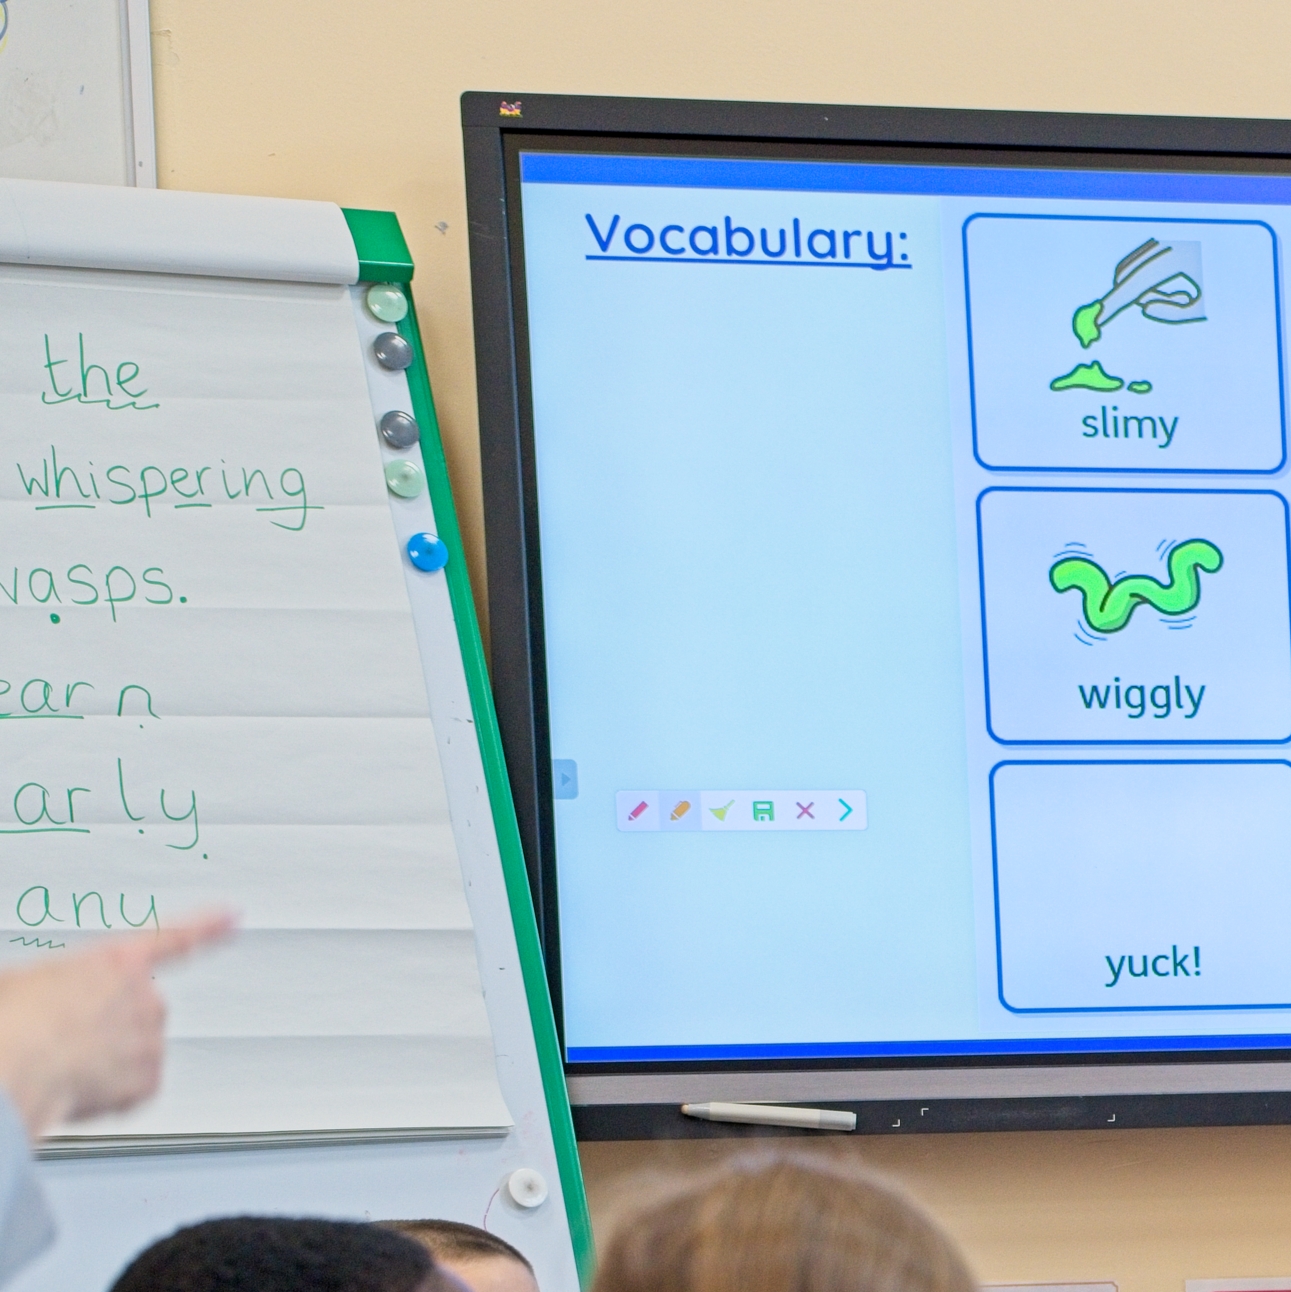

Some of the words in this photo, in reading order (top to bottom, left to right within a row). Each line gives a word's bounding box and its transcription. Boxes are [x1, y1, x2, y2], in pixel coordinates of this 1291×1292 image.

[586, 211, 910, 271] Vocabulary:
[44, 332, 149, 399] the
[1081, 406, 1179, 449] slimy
[16, 445, 309, 531] whispering
[1078, 676, 1206, 720] wiggly
[1104, 944, 1202, 988] yuck!
